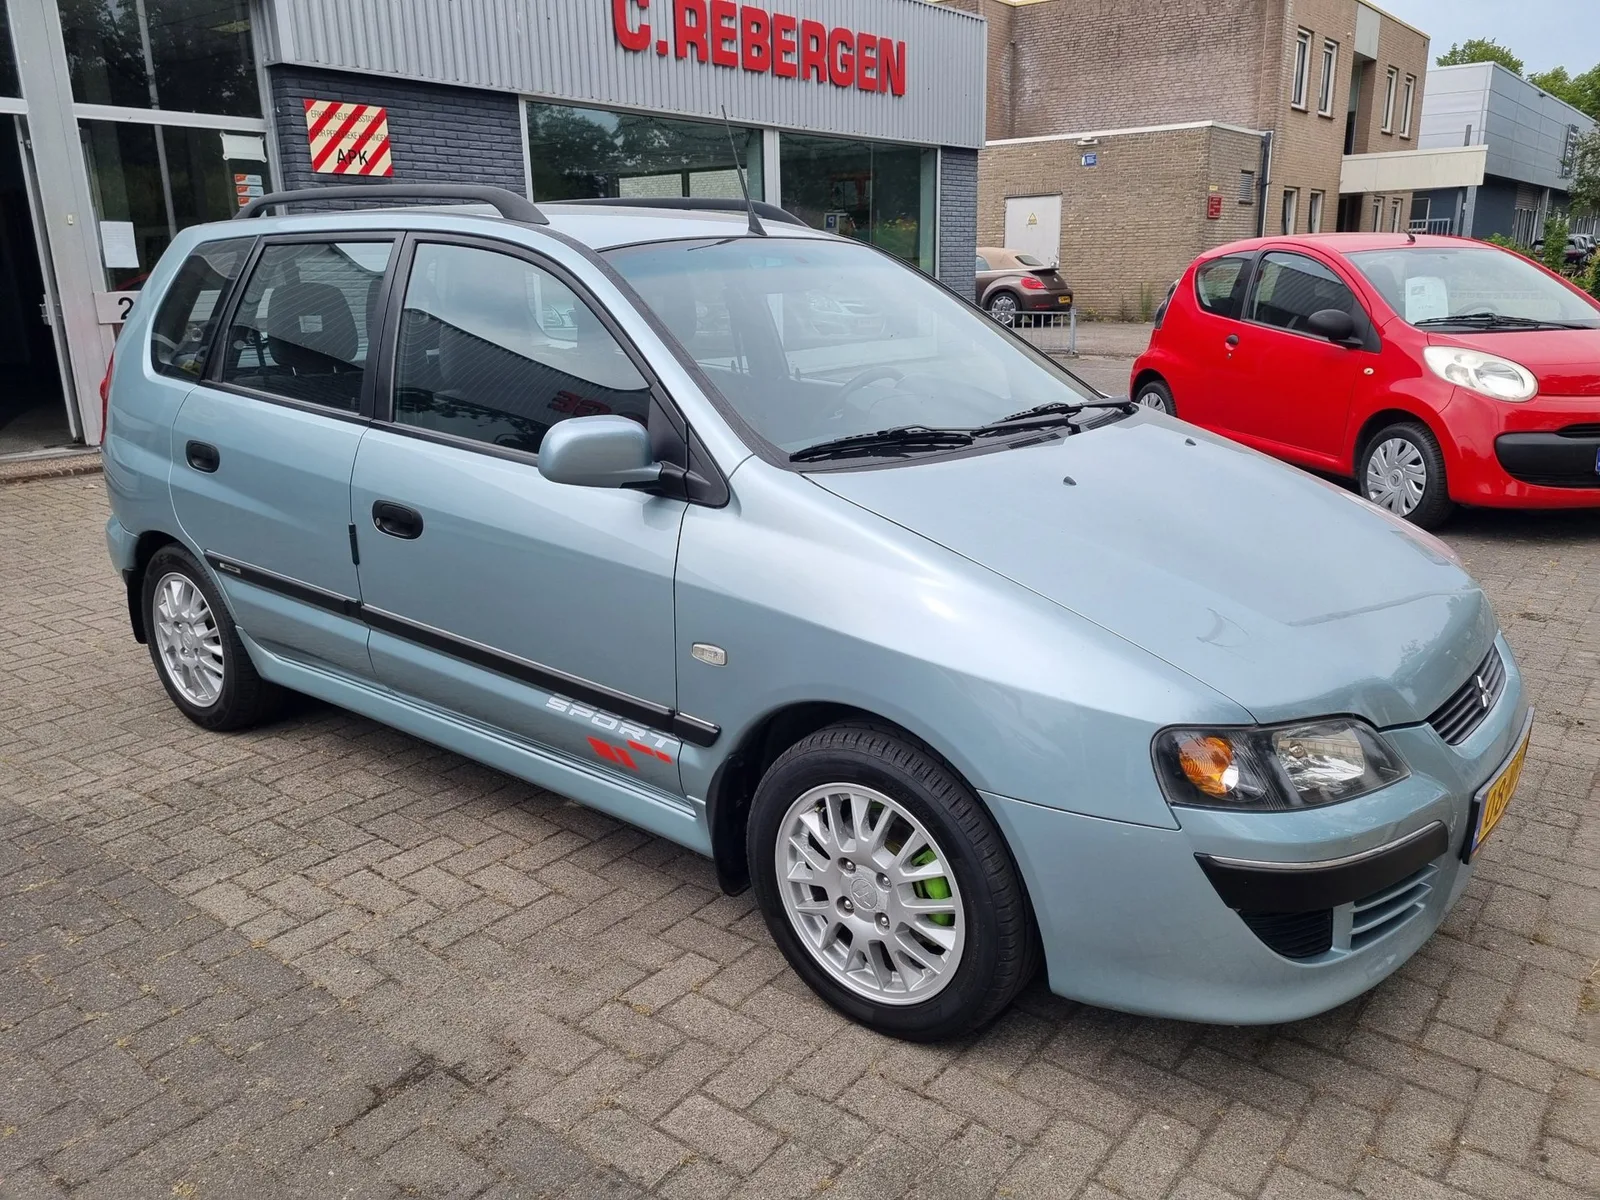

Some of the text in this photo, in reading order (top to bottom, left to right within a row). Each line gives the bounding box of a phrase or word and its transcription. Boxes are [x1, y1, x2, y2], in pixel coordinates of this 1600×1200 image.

[336, 148, 369, 166] APK
[118, 296, 135, 320] 2
[545, 696, 680, 749] SPORT
